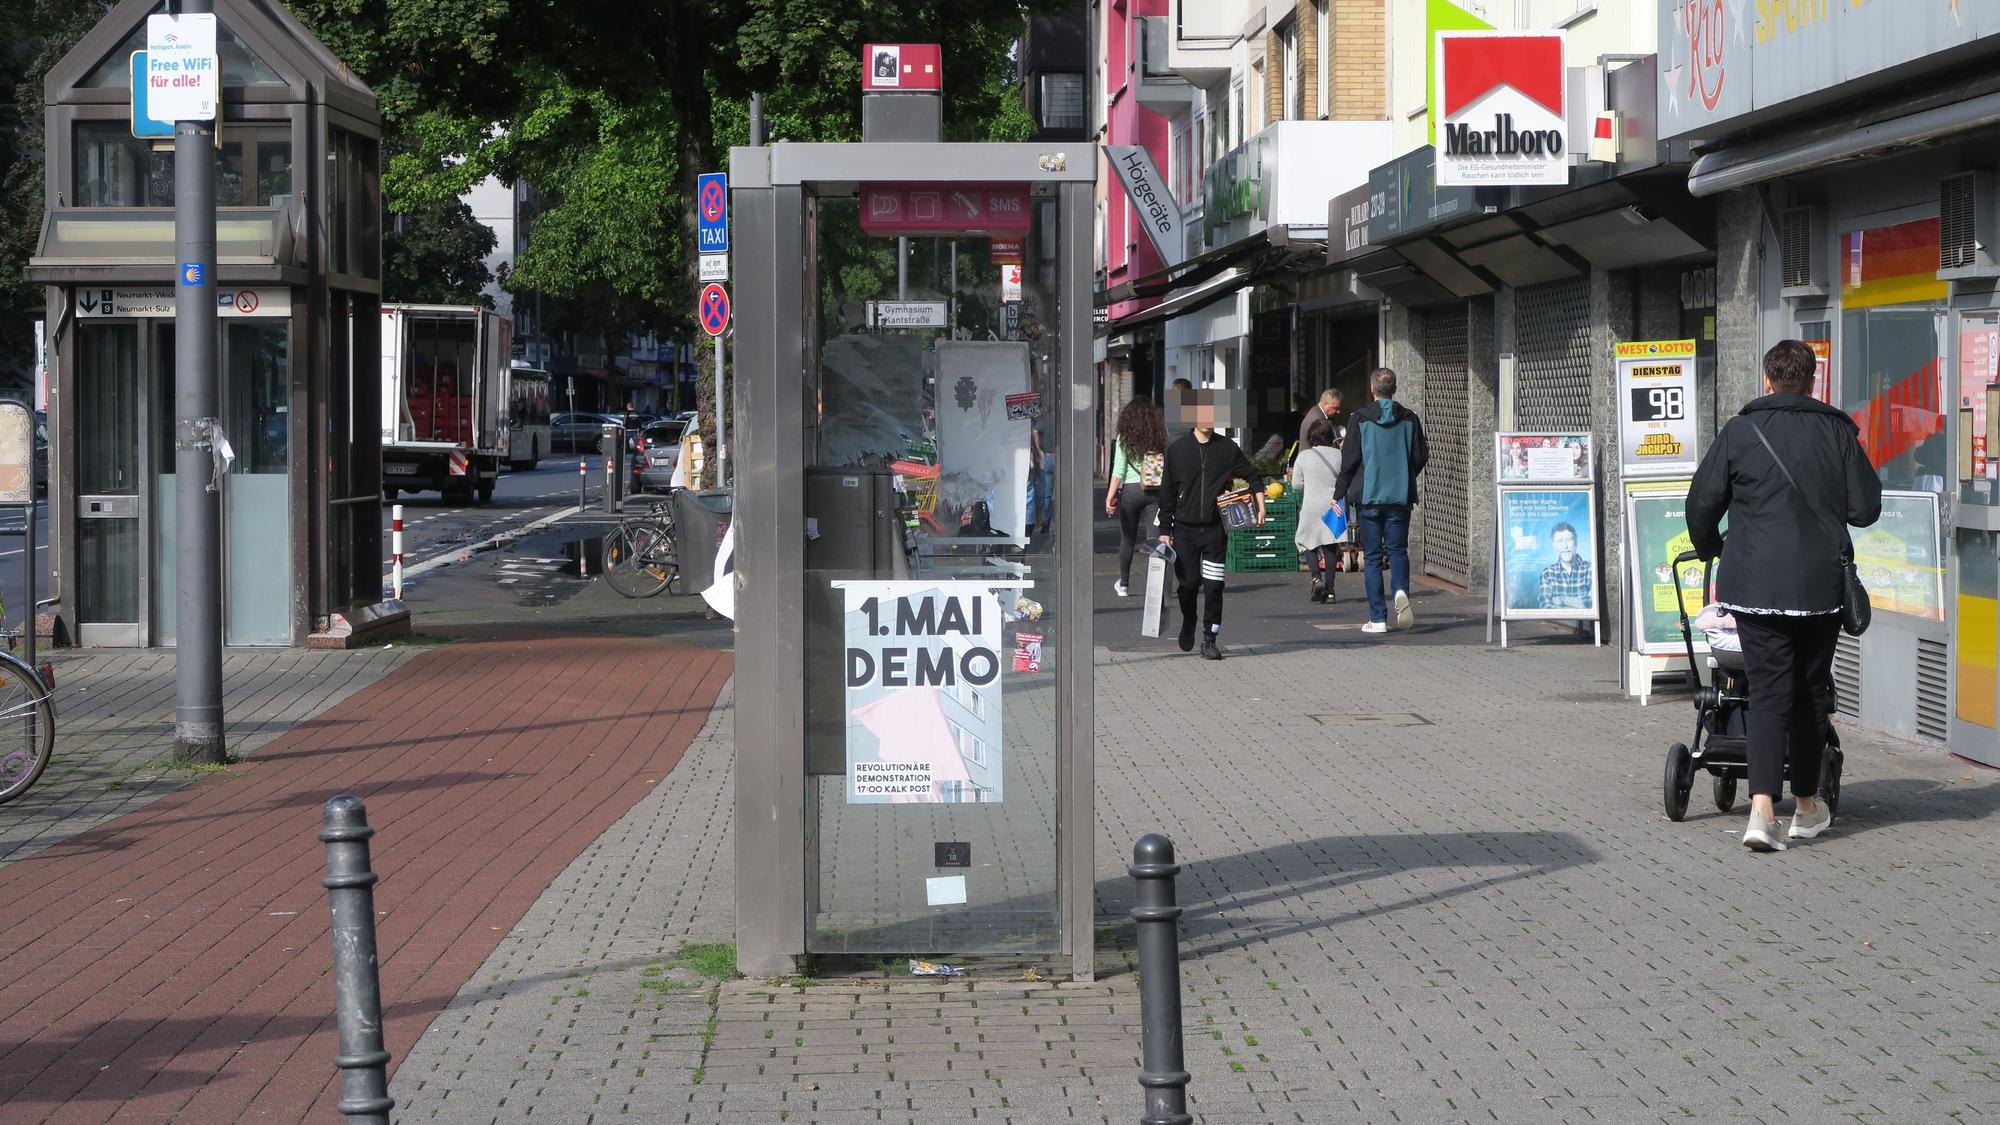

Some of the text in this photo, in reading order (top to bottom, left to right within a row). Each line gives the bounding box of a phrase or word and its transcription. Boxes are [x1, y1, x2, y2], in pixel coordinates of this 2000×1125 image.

[151, 58, 212, 71] Free WiFi
[150, 74, 201, 87] für alle!
[1445, 113, 1562, 155] Marlboro
[1122, 152, 1171, 234] Hörgeräte
[990, 199, 1020, 212] SMS
[701, 228, 725, 244] TAXI
[884, 305, 933, 315] Gymnasium
[886, 316, 931, 325] Kantstraße
[1617, 342, 1695, 355] WEST LOTTO
[1633, 366, 1681, 376] DIENSTAG
[1649, 389, 1684, 420] 98
[1643, 433, 1672, 445] EURO
[1635, 443, 1681, 456] JACKPOT
[847, 647, 1000, 687] DEMO
[857, 762, 931, 772] REVOLUTIONÄRE
[857, 774, 931, 783] DEMONSTRATION
[909, 785, 931, 793] POST
